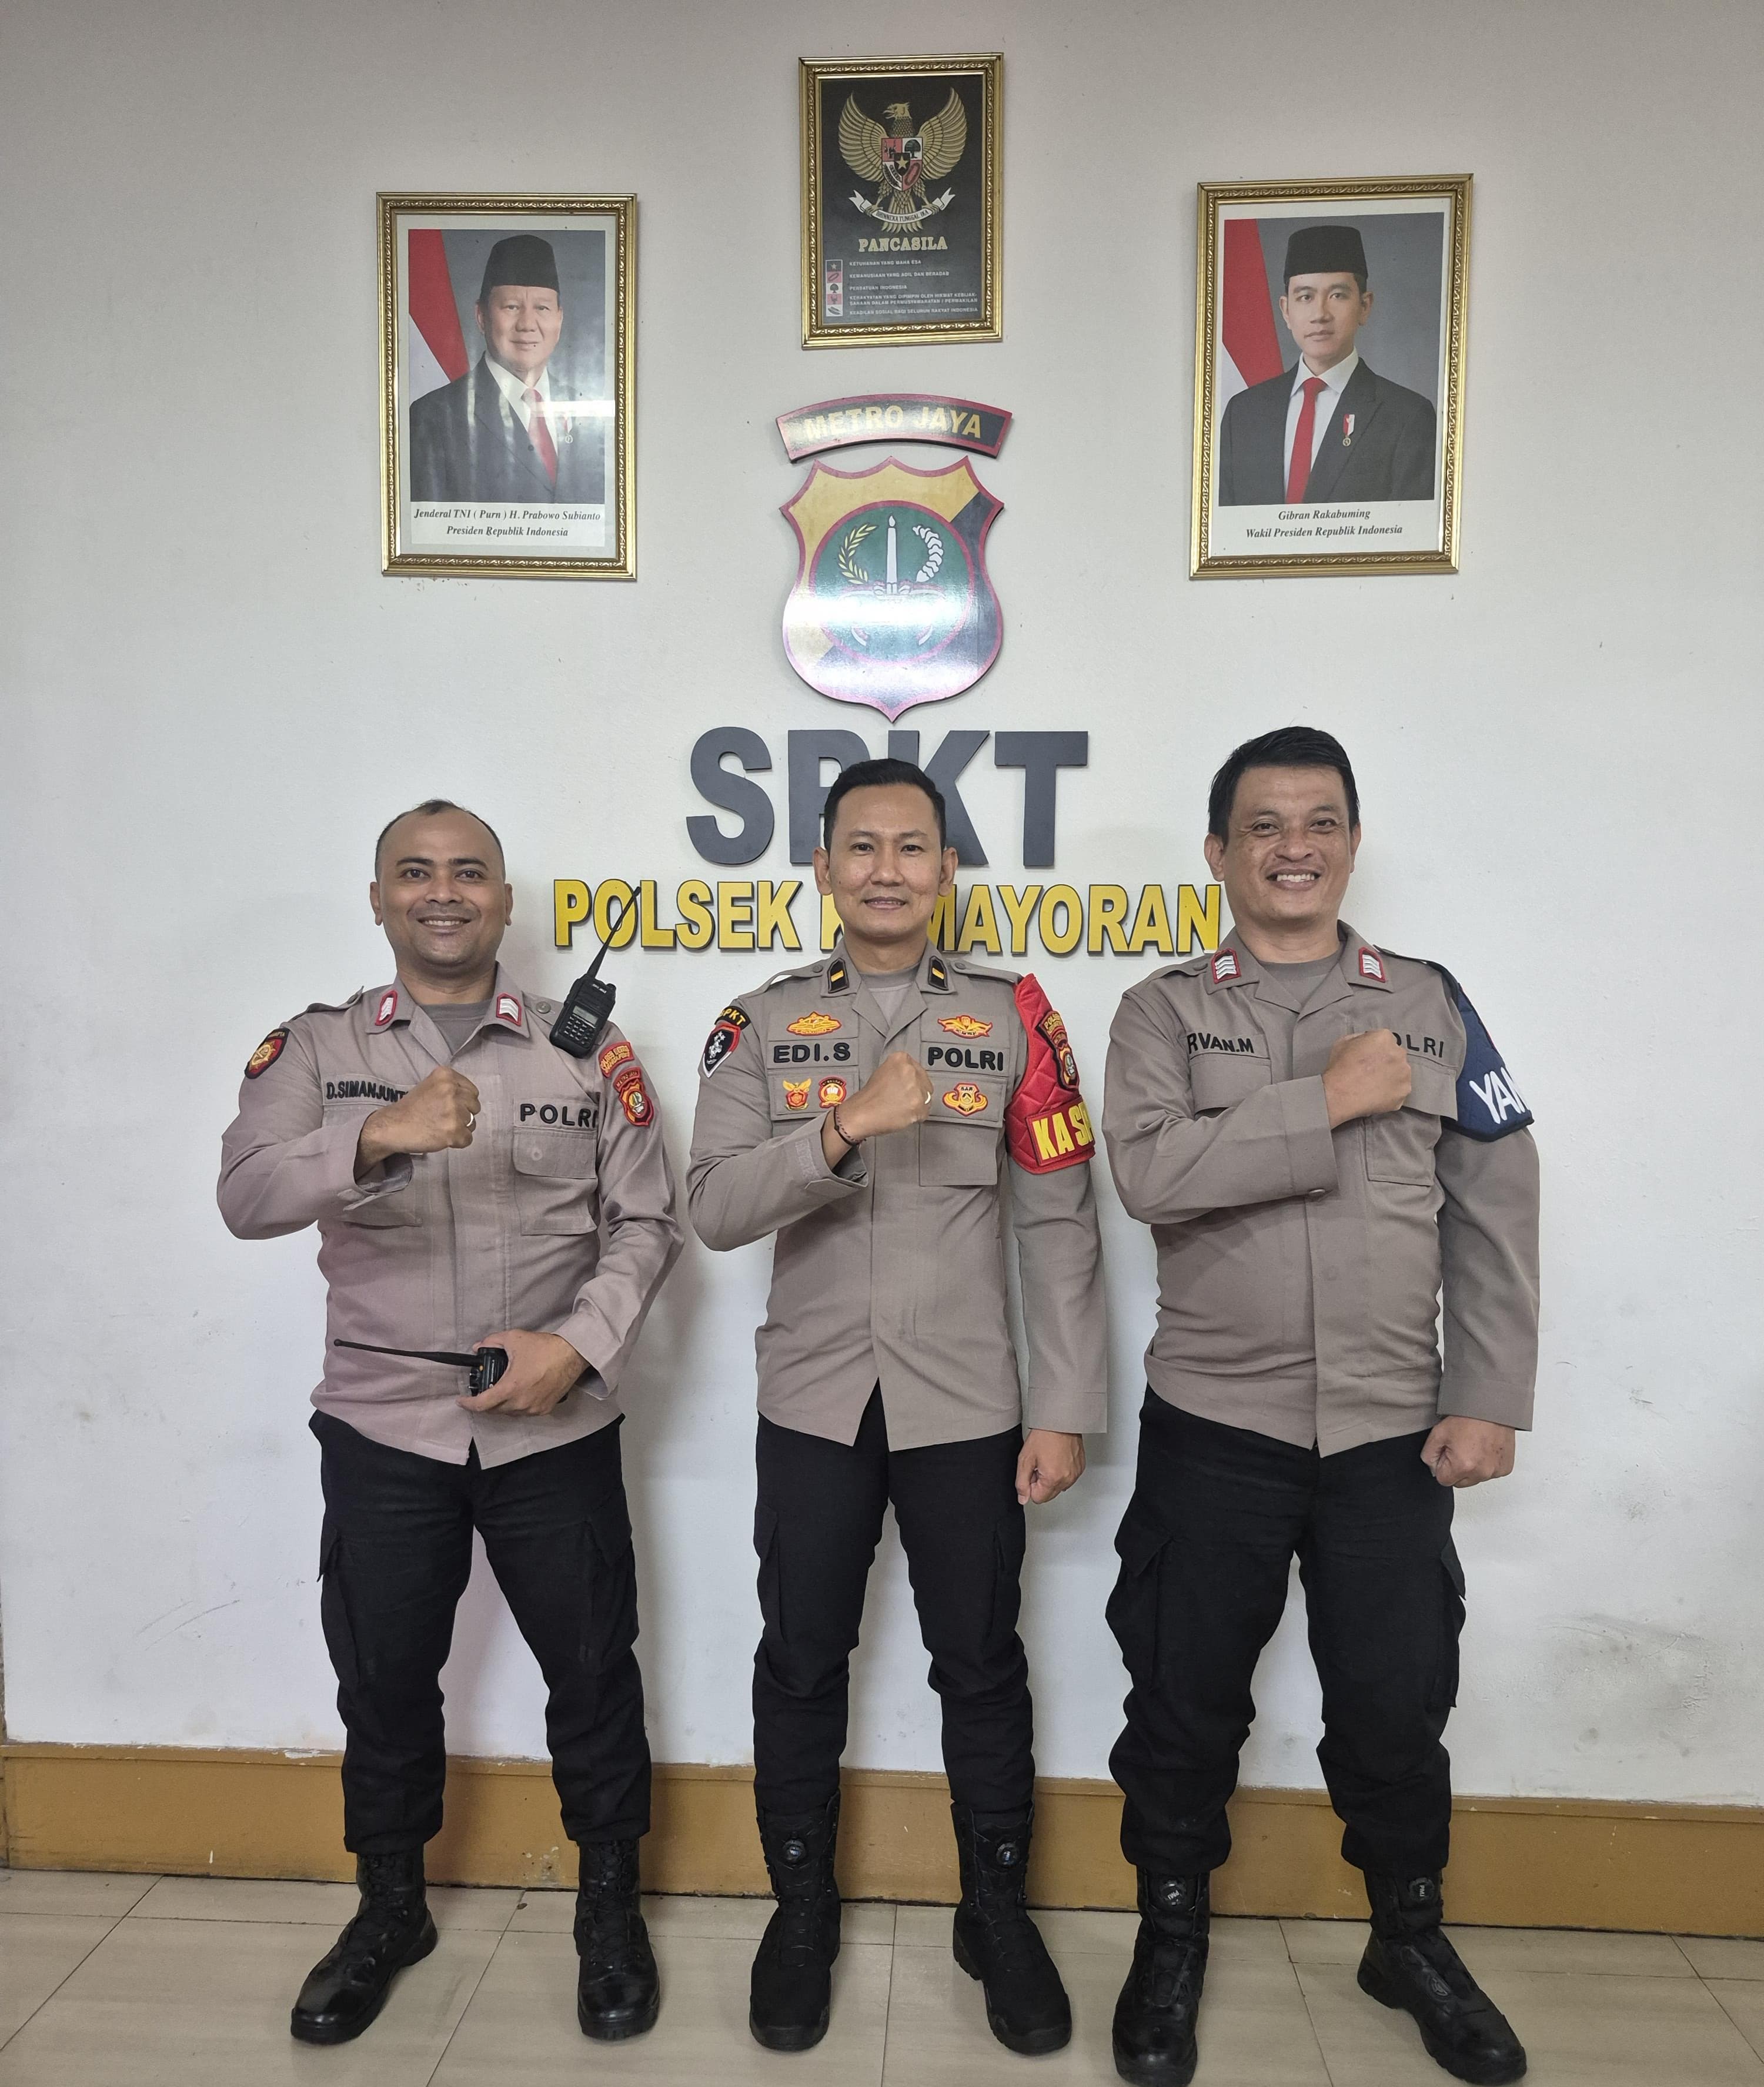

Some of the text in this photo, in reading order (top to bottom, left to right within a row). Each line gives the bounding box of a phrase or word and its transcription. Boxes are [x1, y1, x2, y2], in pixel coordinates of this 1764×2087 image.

[858, 236, 948, 252] PANCASILA
[804, 405, 981, 439] METRO JAYA
[413, 509, 451, 519] Jenderal
[453, 509, 471, 519] TNI
[509, 510, 520, 520] H.
[522, 510, 560, 520] Prabowo
[562, 511, 601, 521] Subianto
[1278, 509, 1371, 520] Gibran Rakabuming
[447, 525, 569, 537] Presiden Republik Indonesia
[1246, 524, 1403, 538] Wakil Presiden Republik Indonesia
[554, 878, 803, 950] POLSEK
[773, 1042, 851, 1063] EDI.S
[927, 1046, 1004, 1071] POLRI
[326, 1081, 409, 1102] D.SIMANJUNT
[520, 1103, 598, 1128] POLRI
